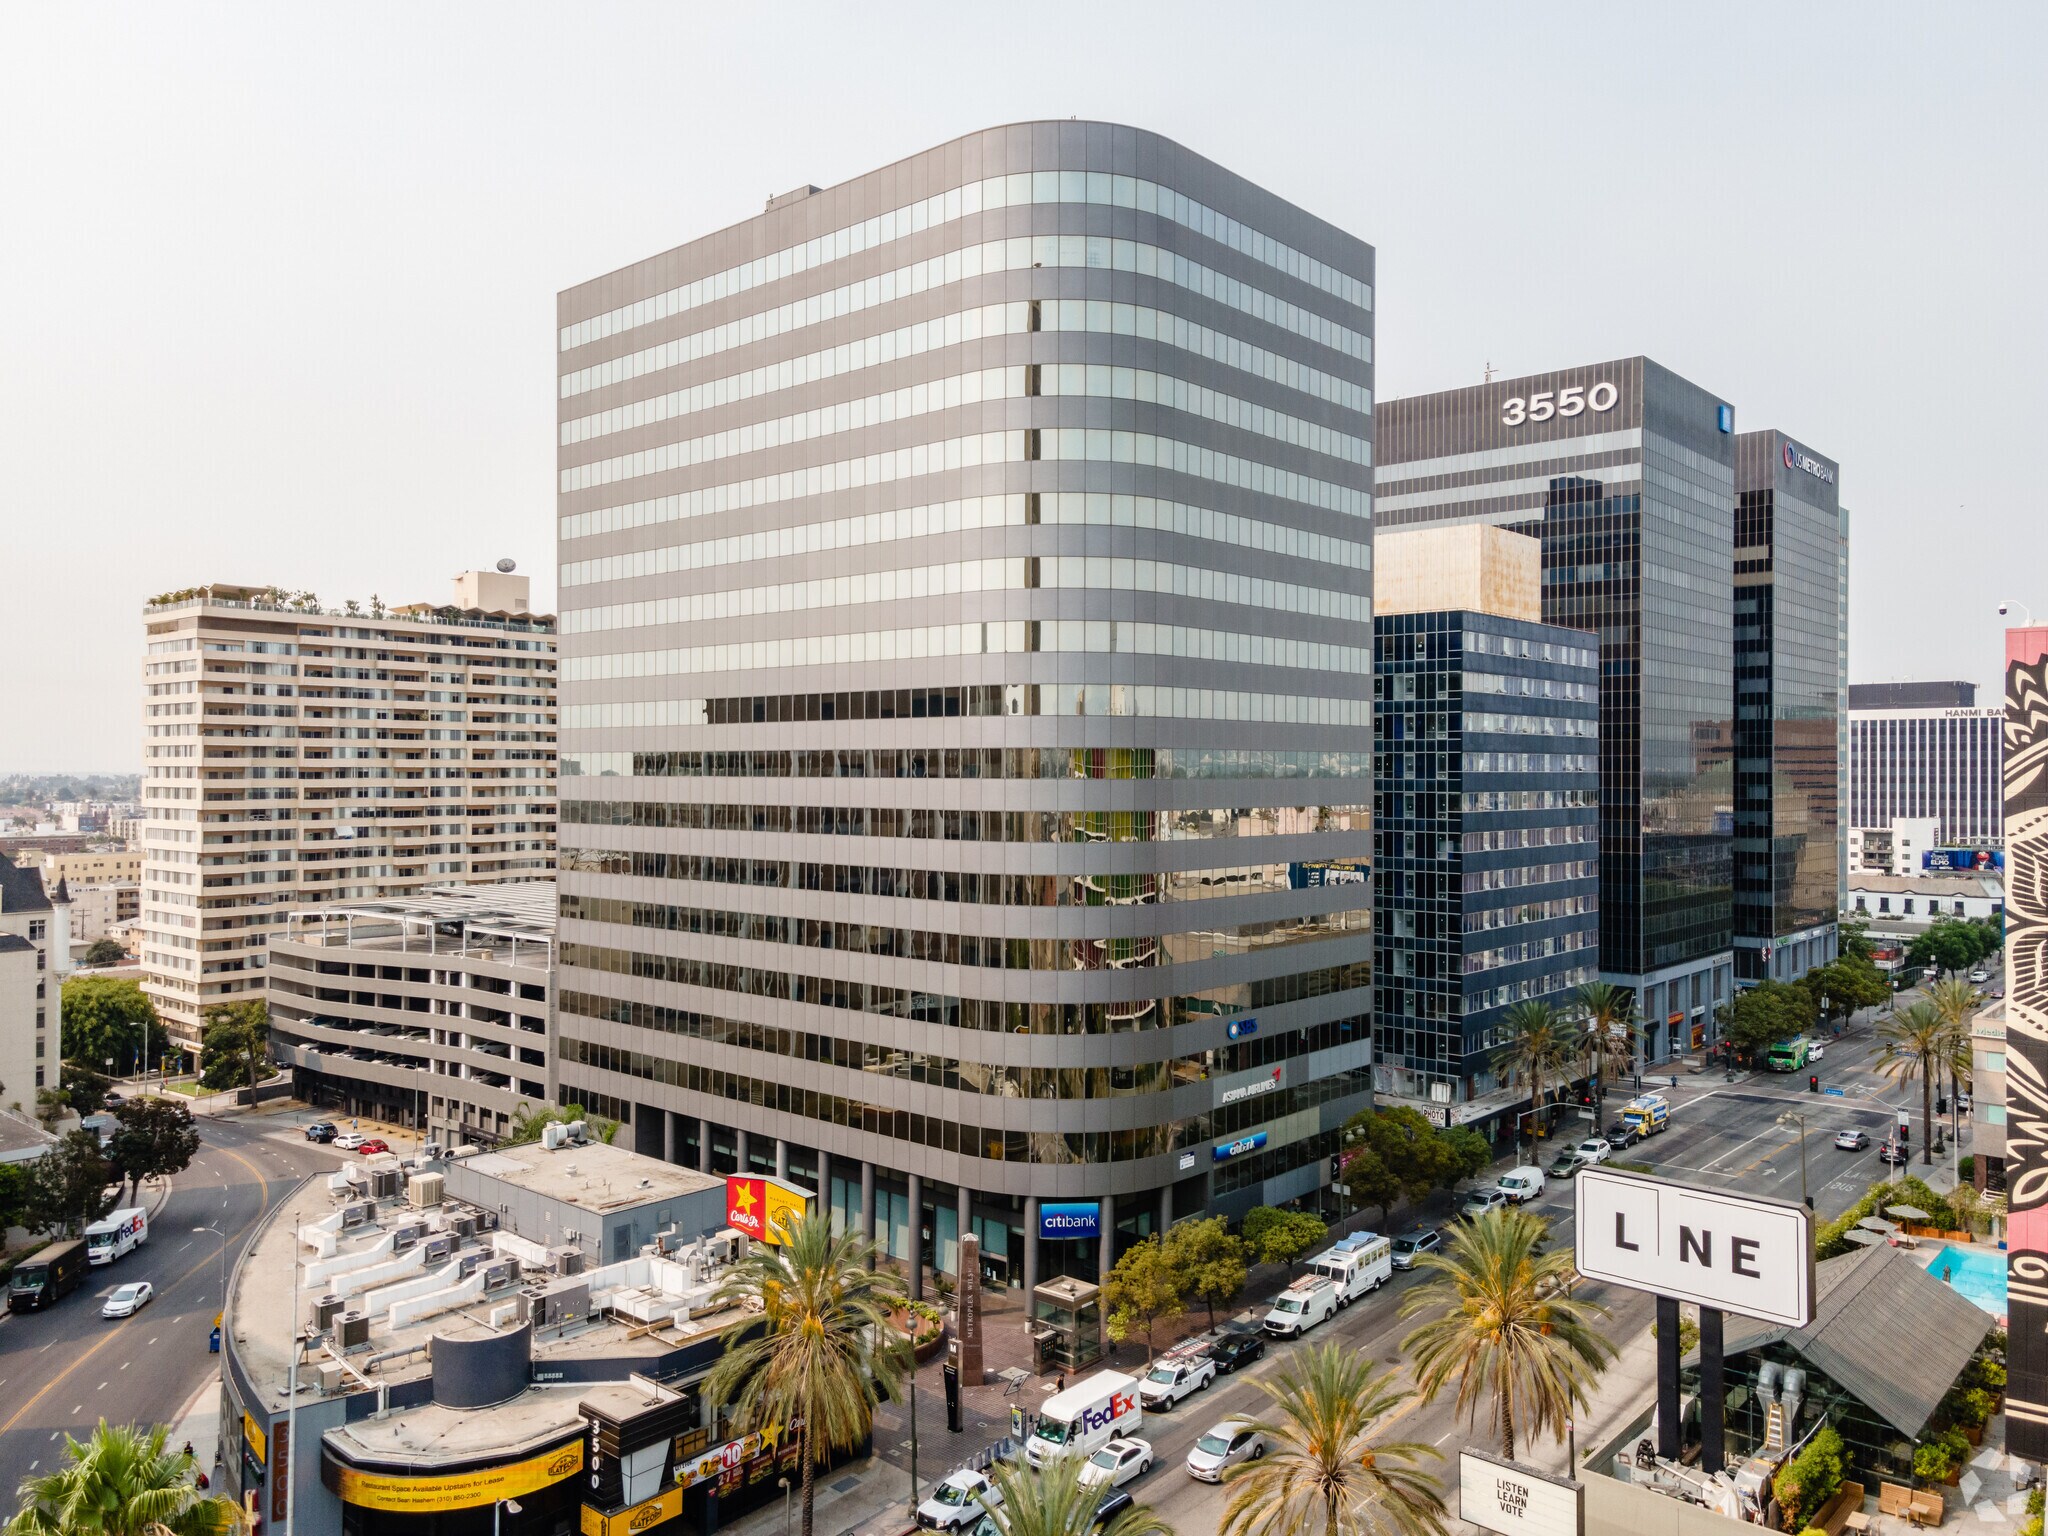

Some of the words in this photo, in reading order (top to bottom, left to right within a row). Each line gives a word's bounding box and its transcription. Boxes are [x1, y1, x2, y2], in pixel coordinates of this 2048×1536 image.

[1502, 382, 1618, 426] 3550
[1802, 456, 1820, 478] METRO
[1945, 709, 1981, 717] HANMI
[1239, 1018, 1257, 1036] SBS
[1222, 1087, 1247, 1103] ASIANA
[1247, 1079, 1276, 1096] AIRLINES
[1230, 1138, 1255, 1156] citibank
[1830, 1182, 1857, 1192] BUS
[121, 1215, 144, 1241] FedEx
[730, 1210, 749, 1225] Carl's
[748, 1216, 760, 1228] Jr.
[1045, 1214, 1096, 1228] citibank
[1615, 1190, 1760, 1279] LINE
[1083, 1392, 1135, 1436] FedEx
[1424, 1409, 1444, 1420] PHOTO
[591, 1420, 600, 1489] 3500
[361, 1480, 390, 1492] Restaurant
[392, 1485, 411, 1493] Space
[444, 1482, 472, 1491] Upstairs
[484, 1476, 505, 1485] Lease
[1496, 1478, 1529, 1498] LISTEN
[436, 1495, 452, 1503] (310)
[1497, 1490, 1527, 1508] LEARN
[1500, 1501, 1523, 1518] VOTE
